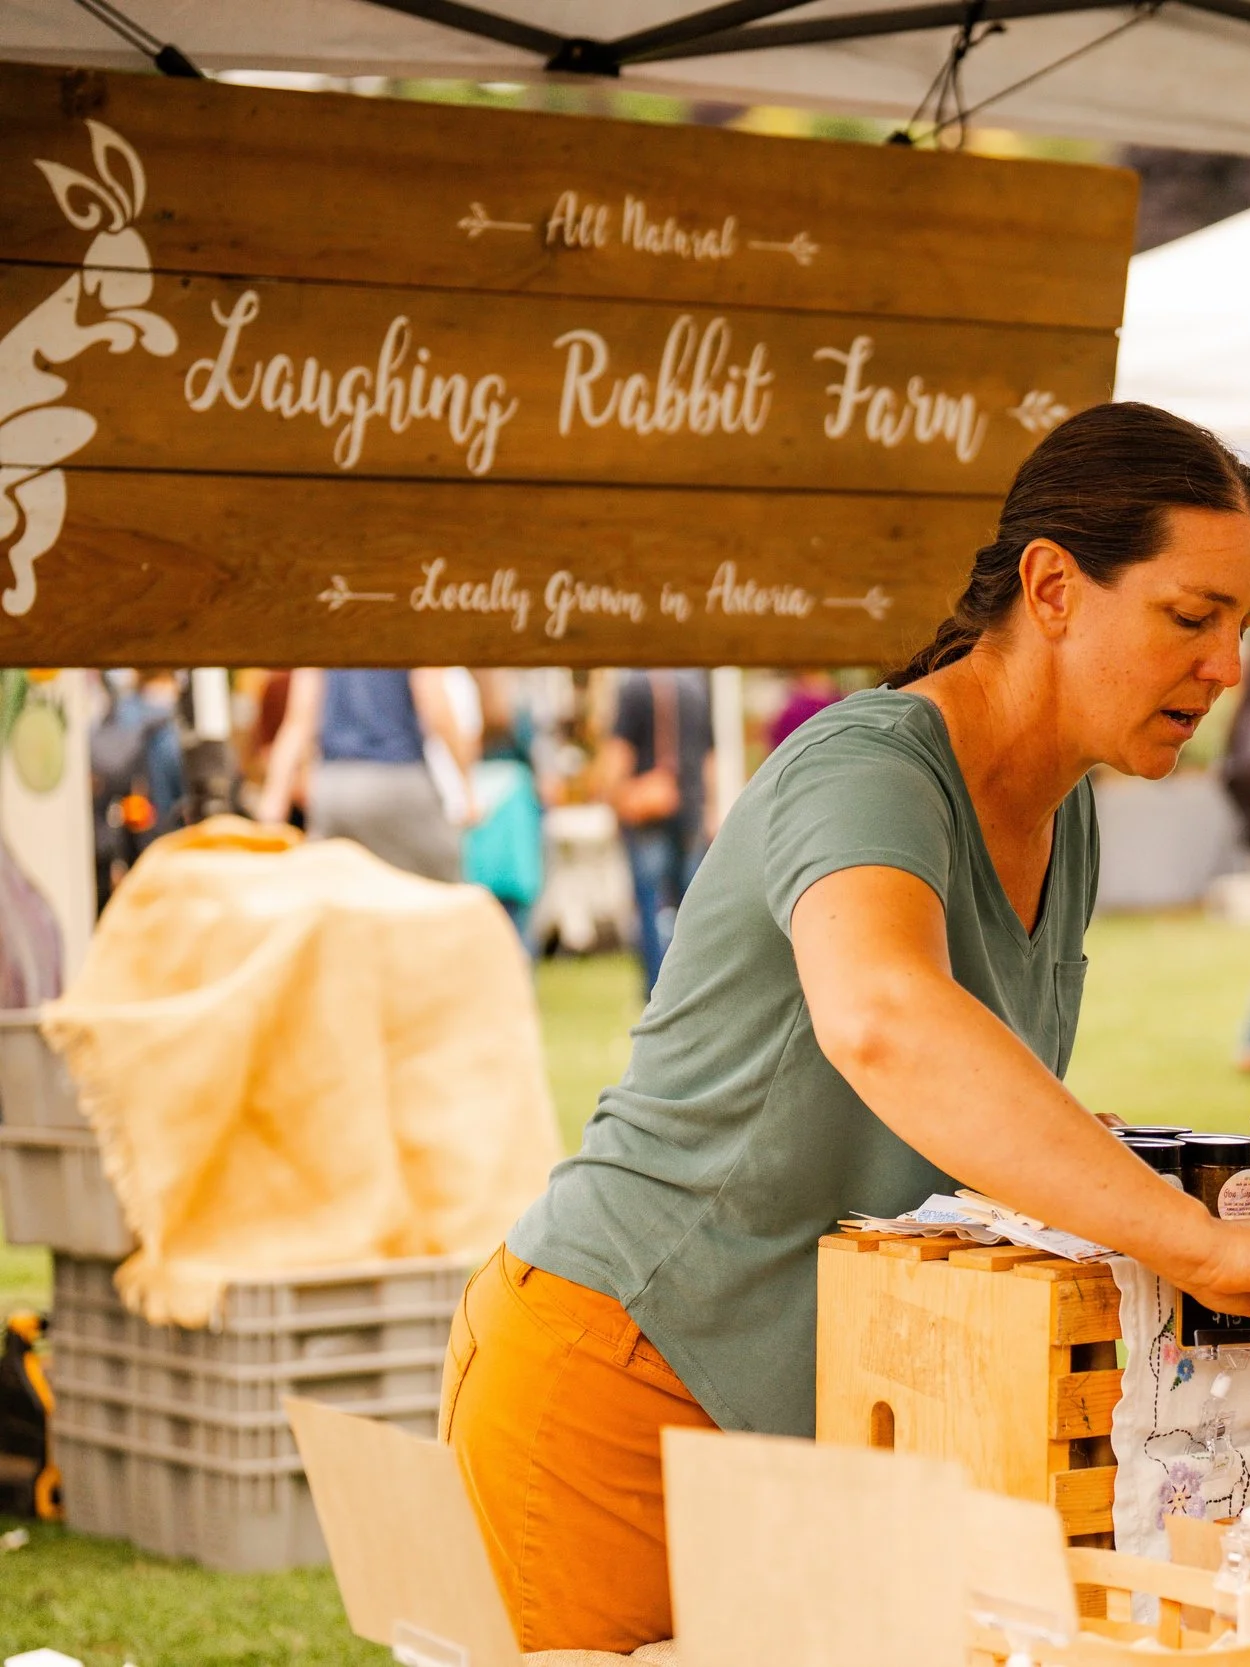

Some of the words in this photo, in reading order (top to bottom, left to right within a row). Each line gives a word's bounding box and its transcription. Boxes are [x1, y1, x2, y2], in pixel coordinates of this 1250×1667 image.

[546, 190, 608, 247] All
[622, 194, 738, 262] Natural
[184, 290, 519, 476] Laughing
[553, 314, 775, 437] Rabbit
[813, 335, 989, 463] Farm
[409, 557, 532, 633] Locally
[544, 568, 646, 639] Grown
[660, 582, 691, 622] in
[705, 560, 817, 619] Astoria
